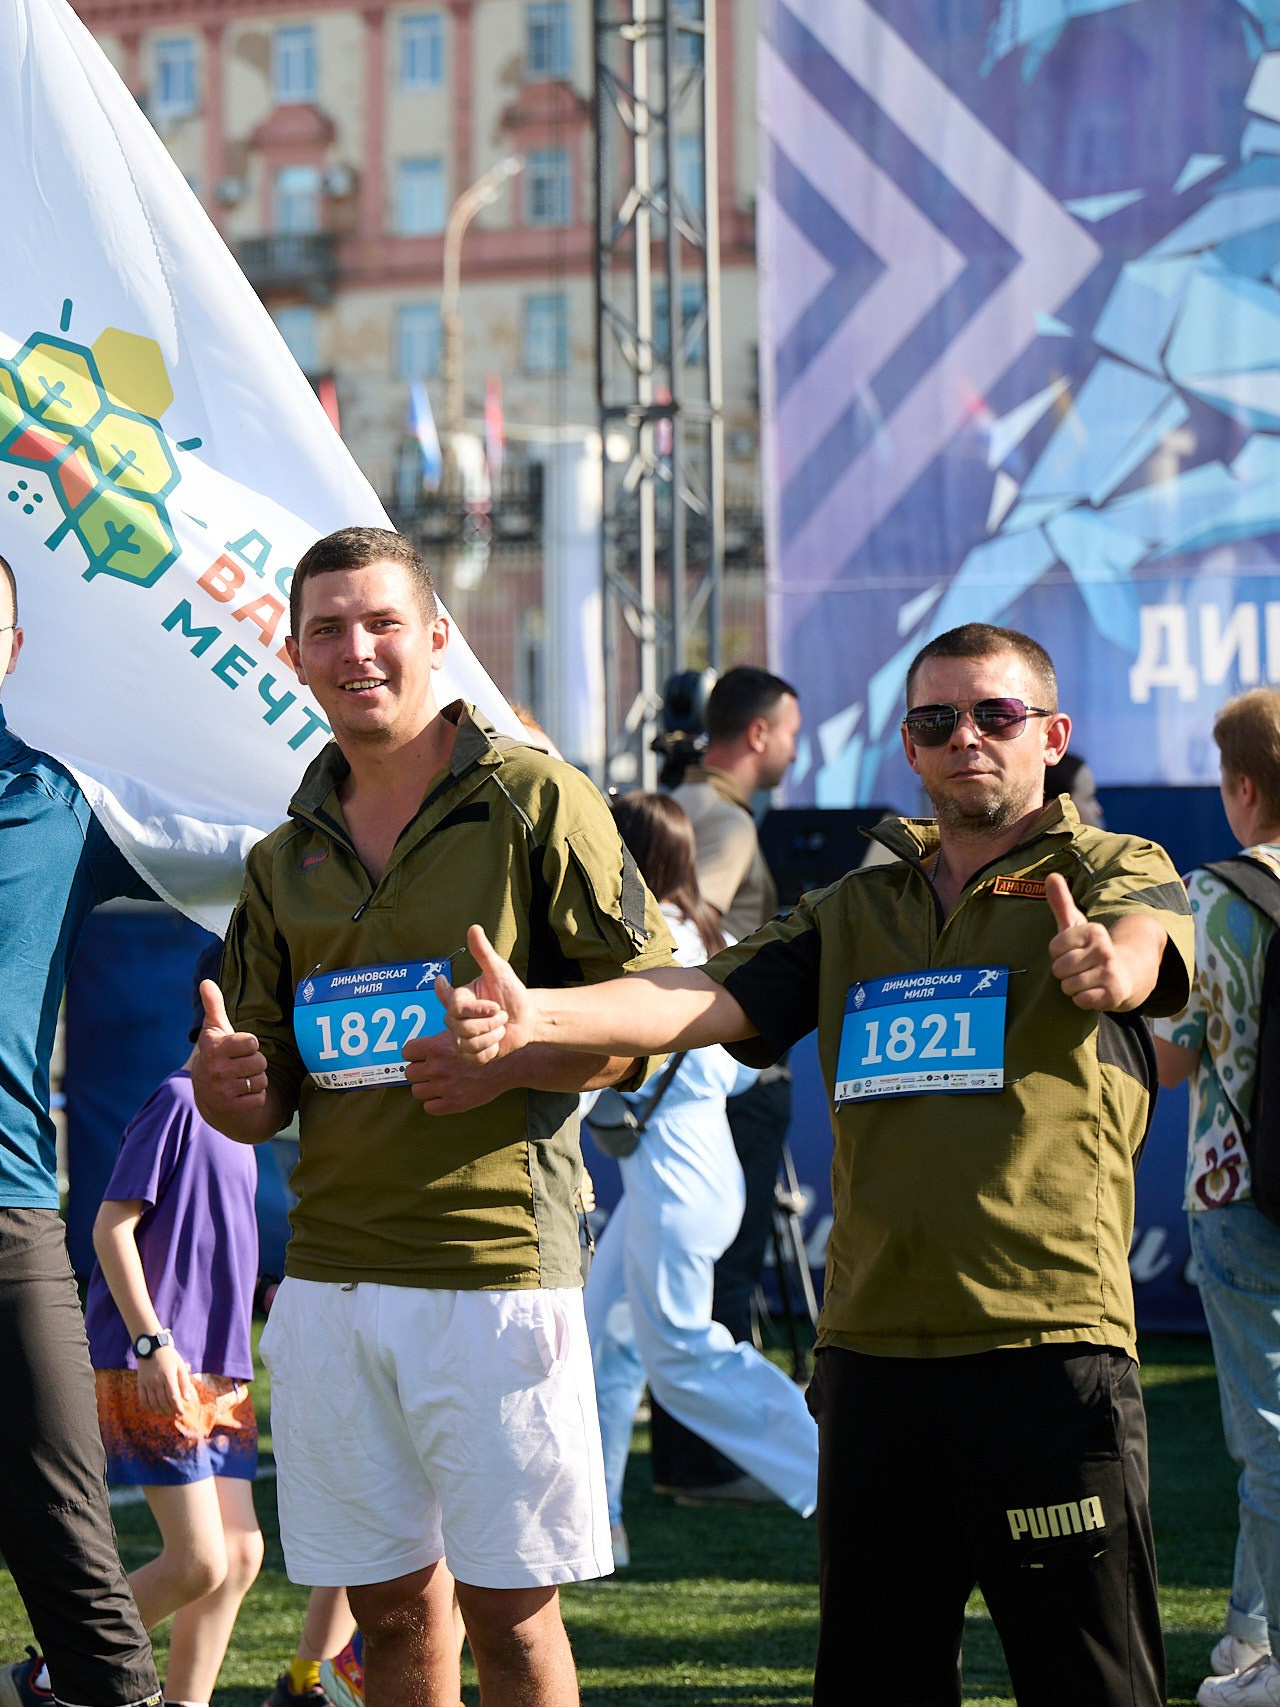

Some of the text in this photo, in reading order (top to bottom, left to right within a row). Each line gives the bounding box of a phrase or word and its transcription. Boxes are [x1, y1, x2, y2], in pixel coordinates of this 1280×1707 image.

[161, 598, 332, 751] МЕЧТ
[330, 968, 408, 988] ДИНАМОВСКАЯ
[353, 982, 383, 995] МИЛЯ
[881, 974, 962, 993] ДИНАМОВСКАЯ
[904, 987, 935, 1000] МИЛЯ
[316, 1004, 427, 1060] 1822
[861, 1011, 976, 1066] 1821
[1006, 1495, 1106, 1540] PUMA
